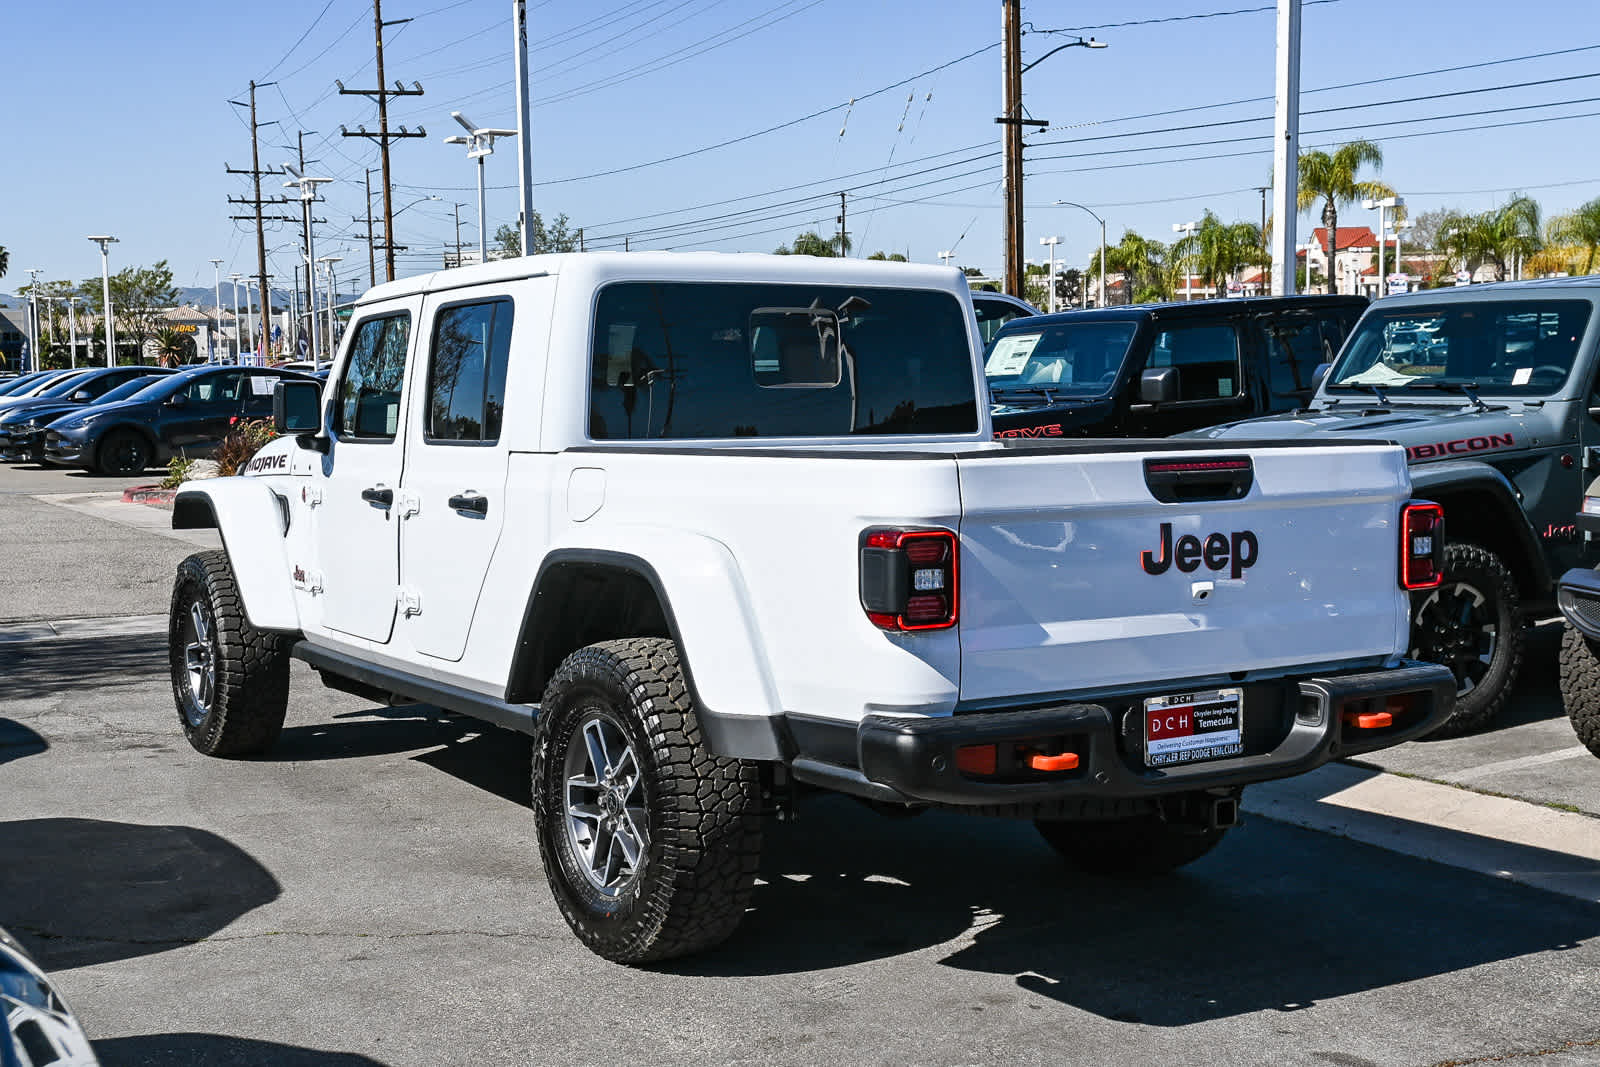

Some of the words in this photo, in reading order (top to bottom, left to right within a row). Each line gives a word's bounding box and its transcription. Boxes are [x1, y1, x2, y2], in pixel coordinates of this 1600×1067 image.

[246, 454, 288, 473] MOJAVE
[1140, 522, 1259, 579] Jeep
[1198, 716, 1233, 728] Temecula
[1151, 753, 1178, 765] CHRYSLER
[1179, 751, 1191, 760] JEEP
[1191, 749, 1211, 760] DODGE
[1211, 745, 1239, 756] TEMECULA
